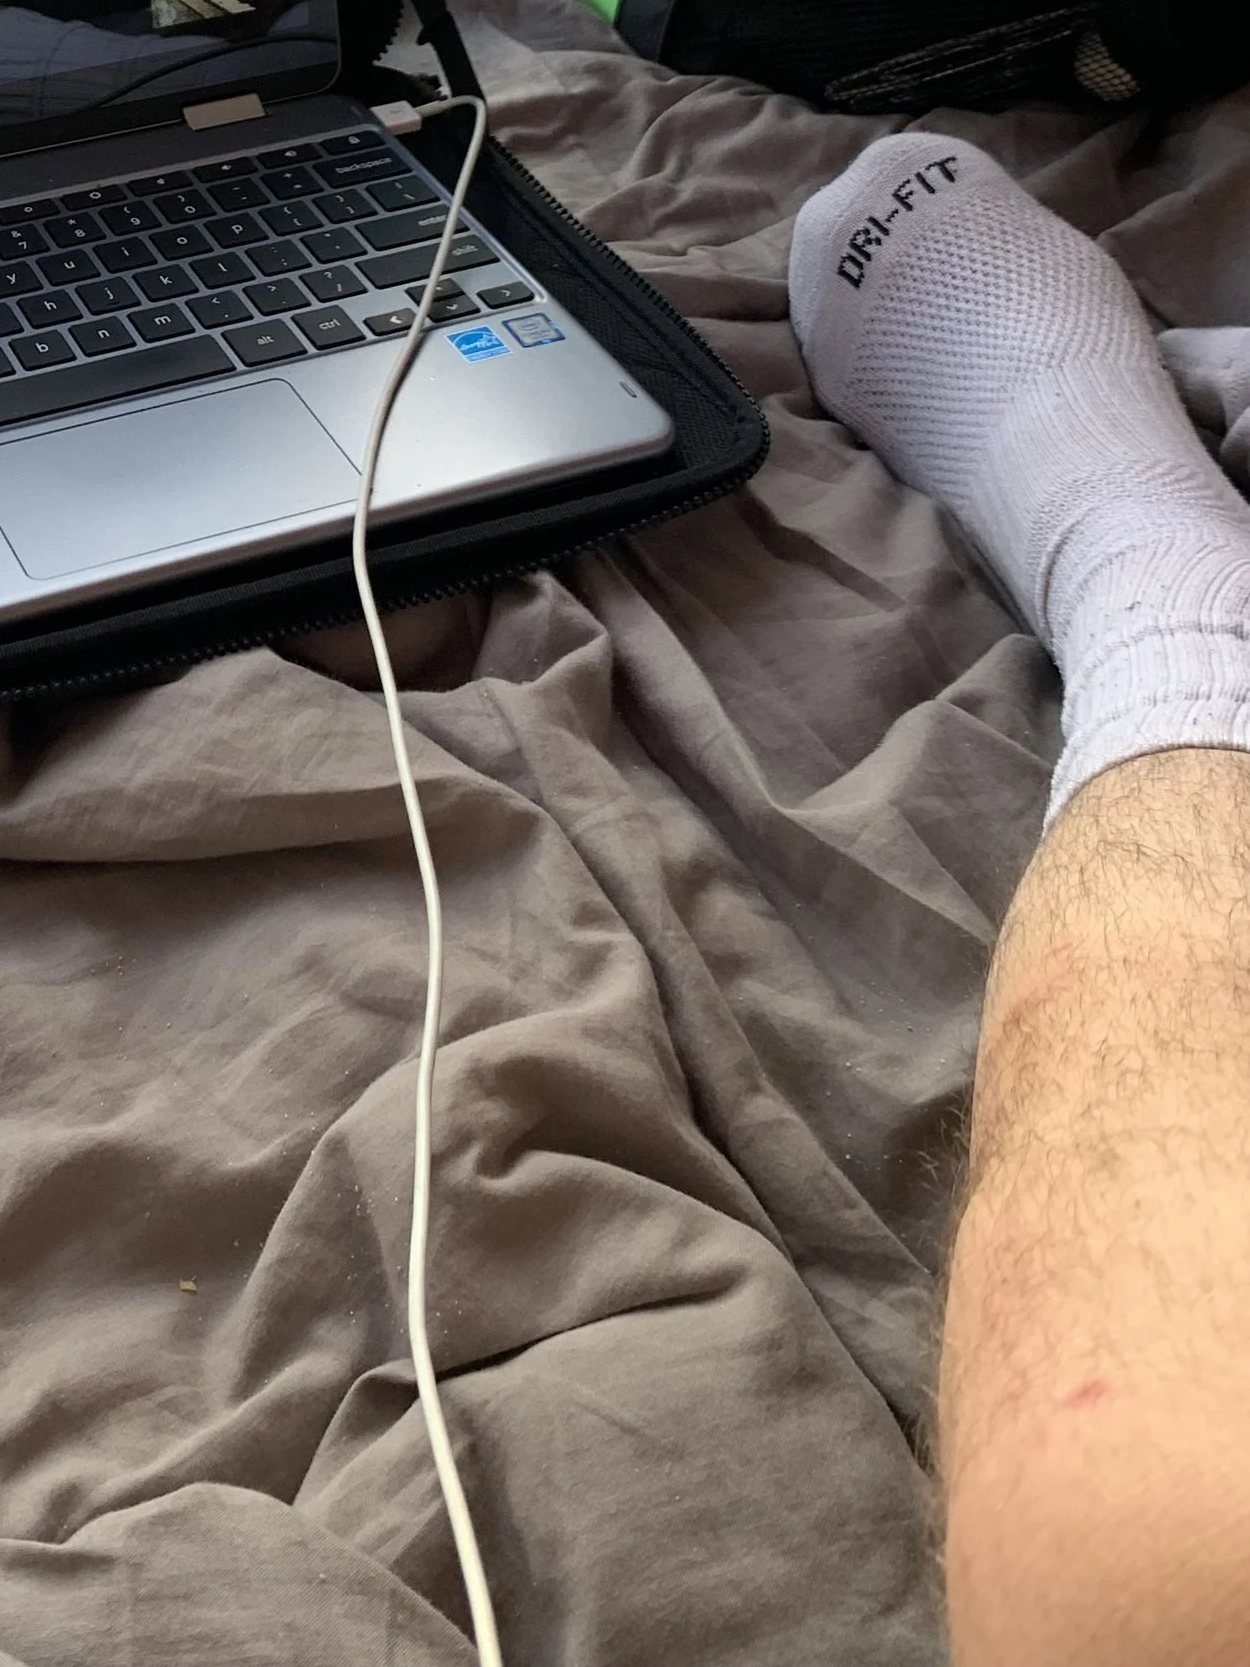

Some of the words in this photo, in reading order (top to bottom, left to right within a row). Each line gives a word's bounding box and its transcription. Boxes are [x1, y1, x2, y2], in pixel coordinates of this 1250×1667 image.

[335, 156, 393, 175] backspace
[184, 205, 196, 214] 0
[129, 217, 141, 226] 9
[836, 155, 958, 289] DRI-FIT
[74, 229, 86, 238] 8
[231, 224, 244, 235] p
[17, 241, 27, 250] 7
[176, 236, 188, 245] o
[121, 246, 130, 257] i
[63, 260, 76, 270] u
[6, 273, 16, 285] y
[159, 275, 173, 285] k
[104, 287, 114, 300] j
[43, 300, 57, 311] h
[154, 315, 172, 325] m
[318, 318, 342, 330] ctrl
[97, 329, 110, 339] n
[256, 335, 275, 345] alt
[35, 342, 49, 353] b
